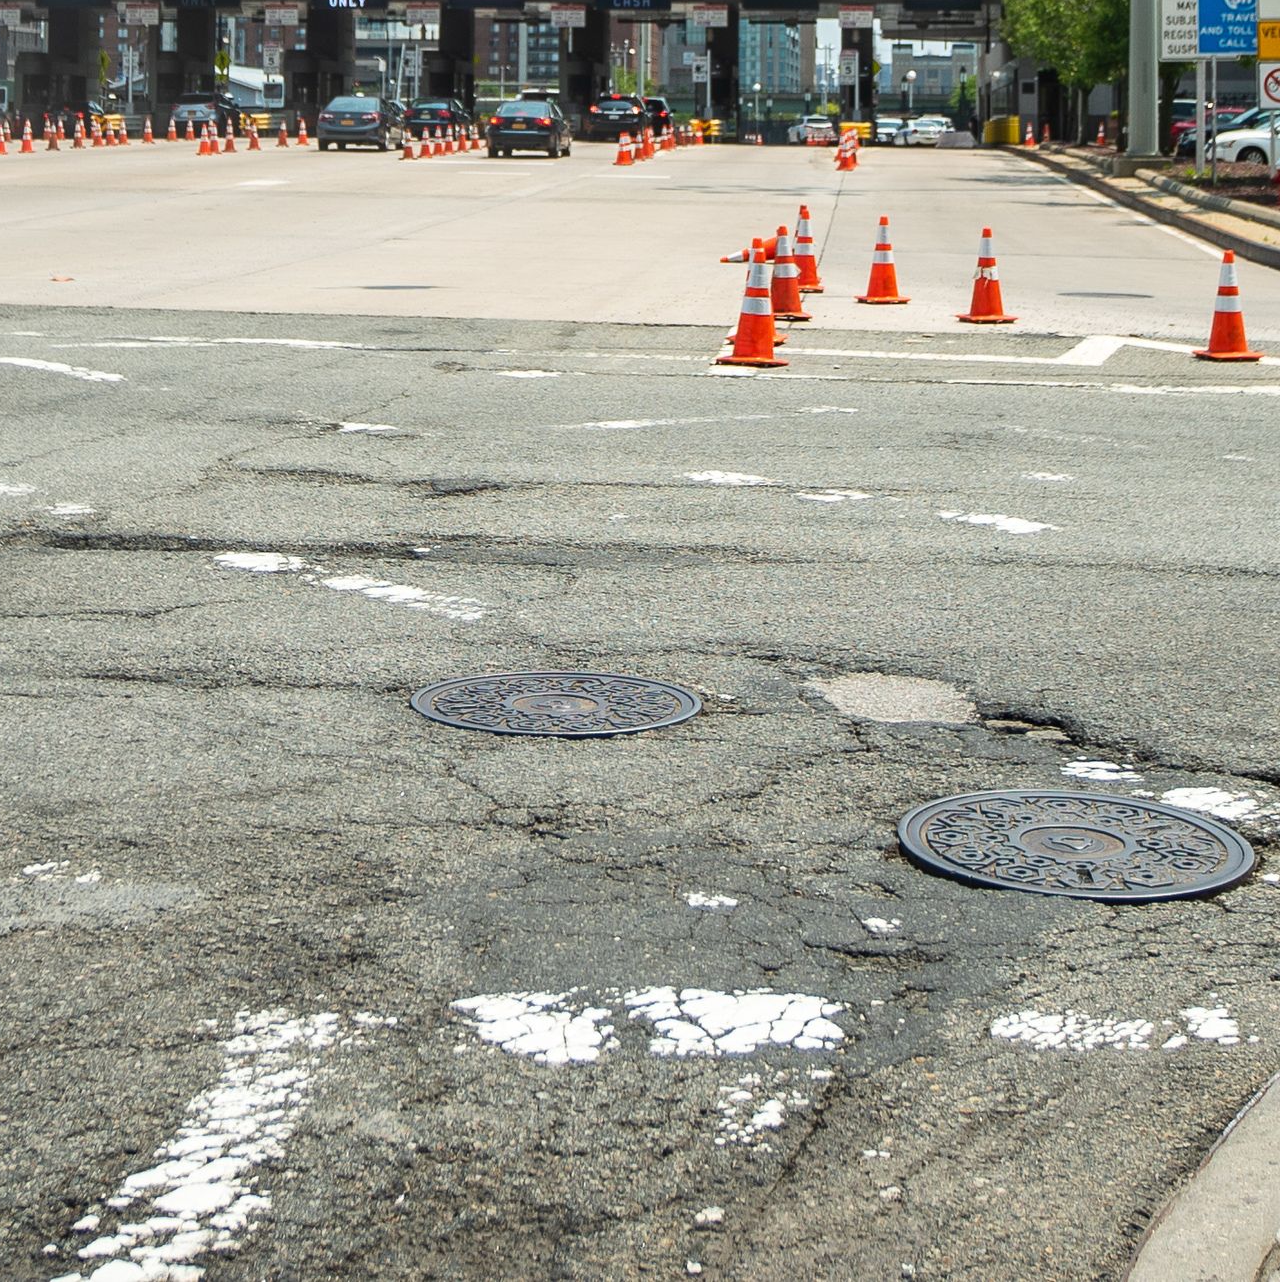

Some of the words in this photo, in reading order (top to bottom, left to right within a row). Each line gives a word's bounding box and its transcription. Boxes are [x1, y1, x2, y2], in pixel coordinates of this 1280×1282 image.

[1176, 1, 1197, 10] MAY
[1200, 26, 1223, 35] AND
[1228, 26, 1254, 35] TOLL
[1219, 38, 1246, 47] CALL
